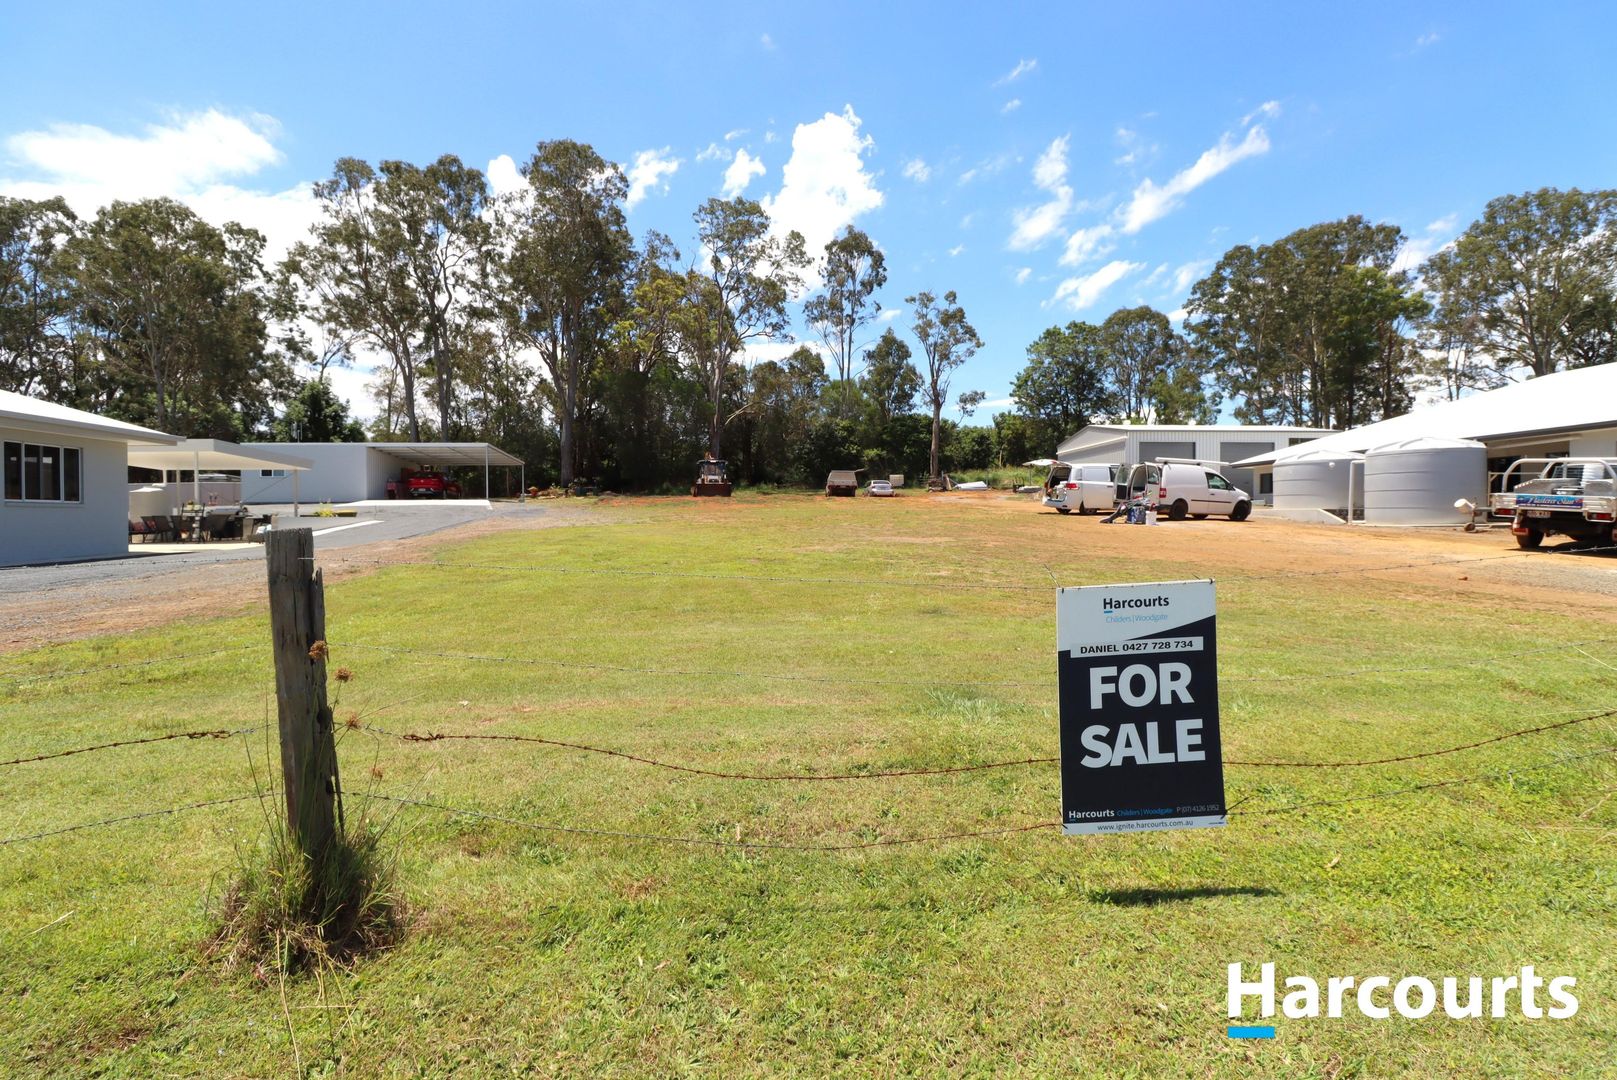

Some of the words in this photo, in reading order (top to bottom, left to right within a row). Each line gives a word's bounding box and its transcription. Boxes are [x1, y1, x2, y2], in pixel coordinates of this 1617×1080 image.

[1103, 596, 1169, 609] Harcourts
[1080, 644, 1119, 654] DANIEL
[1122, 642, 1149, 652] 0427
[1151, 641, 1171, 650] 728
[1174, 640, 1193, 649] 734
[1089, 662, 1195, 710] FOR
[1080, 718, 1206, 769] SALE
[1069, 809, 1114, 818] Harcourts
[1098, 820, 1193, 830] www.ignite.harcourts.com.au
